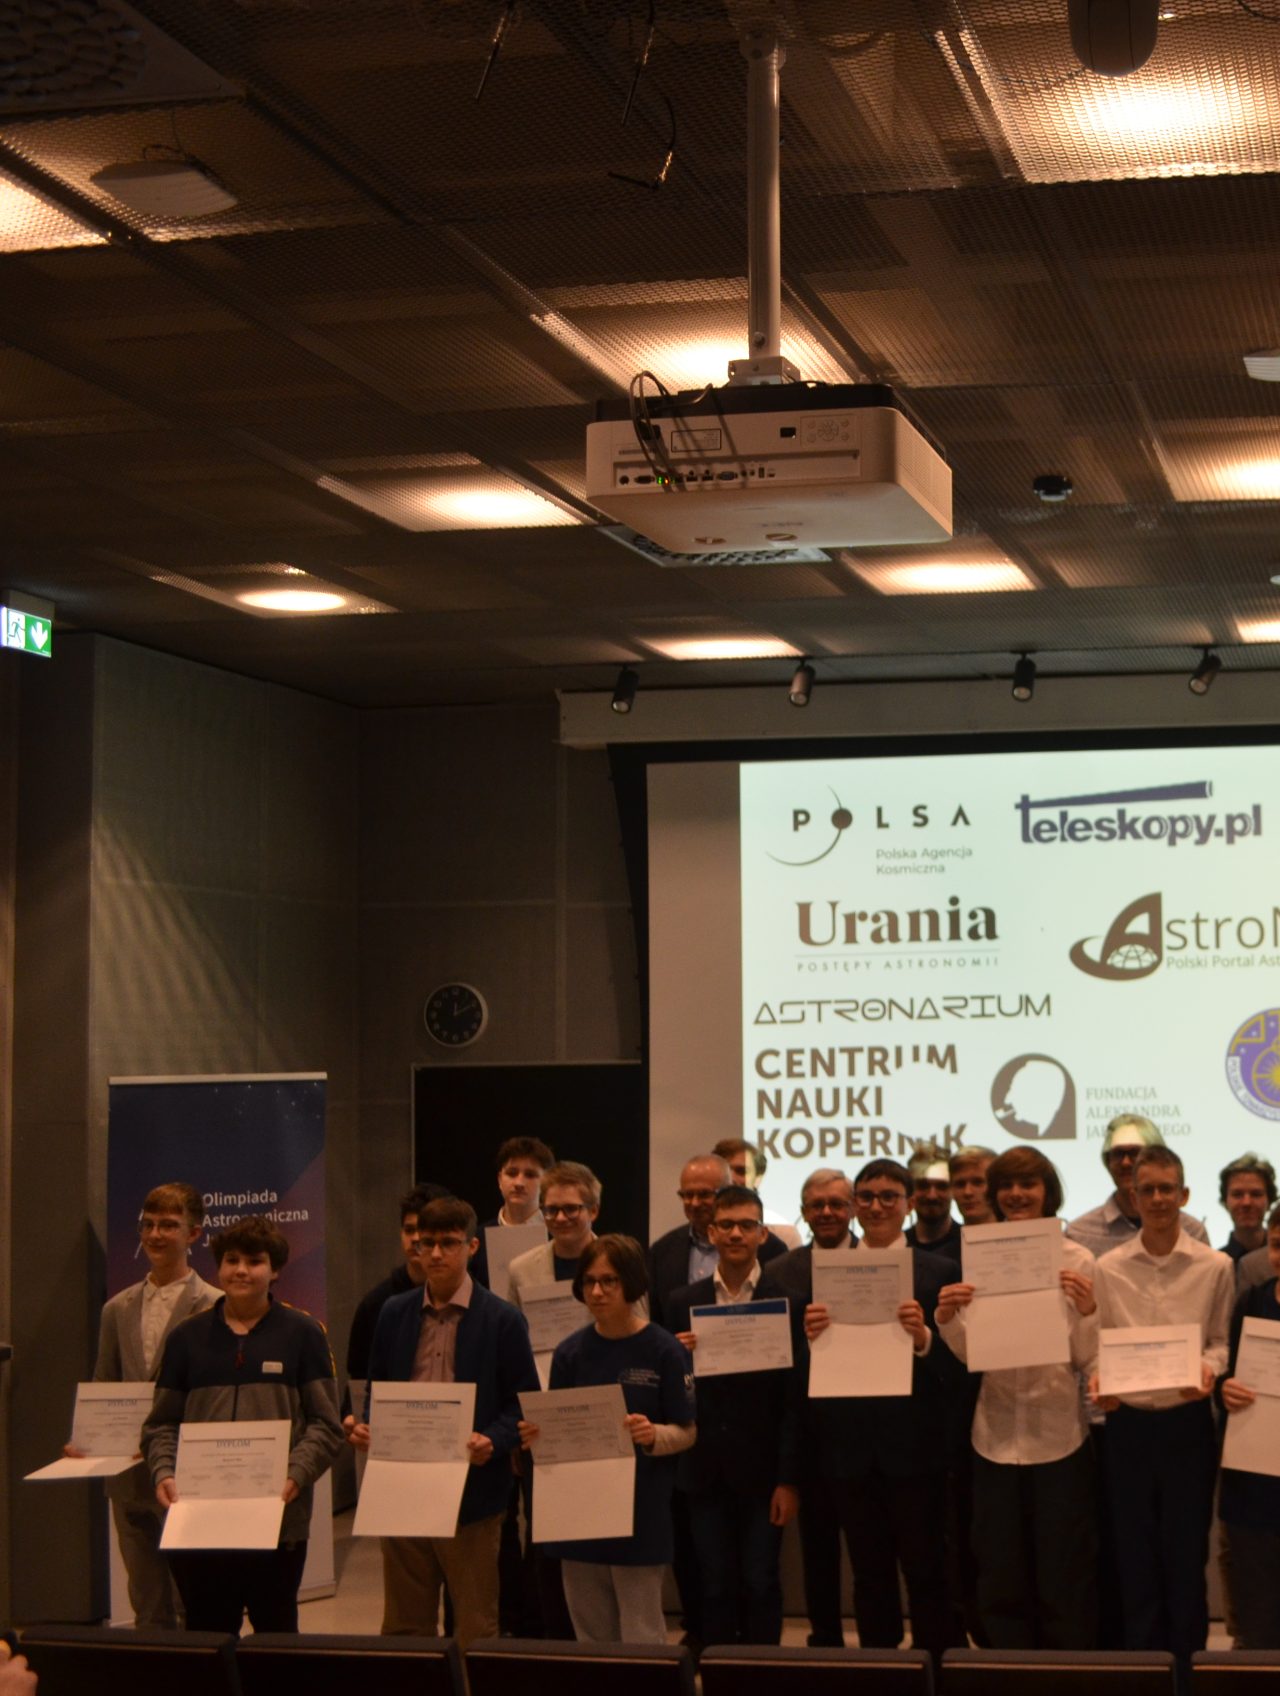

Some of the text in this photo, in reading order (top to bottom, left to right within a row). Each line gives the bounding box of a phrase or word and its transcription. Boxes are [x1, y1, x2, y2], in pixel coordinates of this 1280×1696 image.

[1017, 793, 1262, 847] teleskopy.pl
[876, 845, 973, 860] Polska Agencja
[876, 862, 946, 875] Kosmiczna
[796, 895, 999, 947] Urania
[1166, 954, 1208, 969] Polski
[1212, 953, 1254, 969] Portal
[753, 994, 1052, 1025] ASTRONARIUM
[754, 1044, 958, 1080] CENTRUM
[1085, 1086, 1158, 1101] FUNDACJA
[756, 1086, 884, 1120] NAUKI
[203, 1189, 278, 1208] Olimpiada
[406, 1401, 439, 1410] DYPLOM
[216, 1439, 251, 1448] DYPLOM
